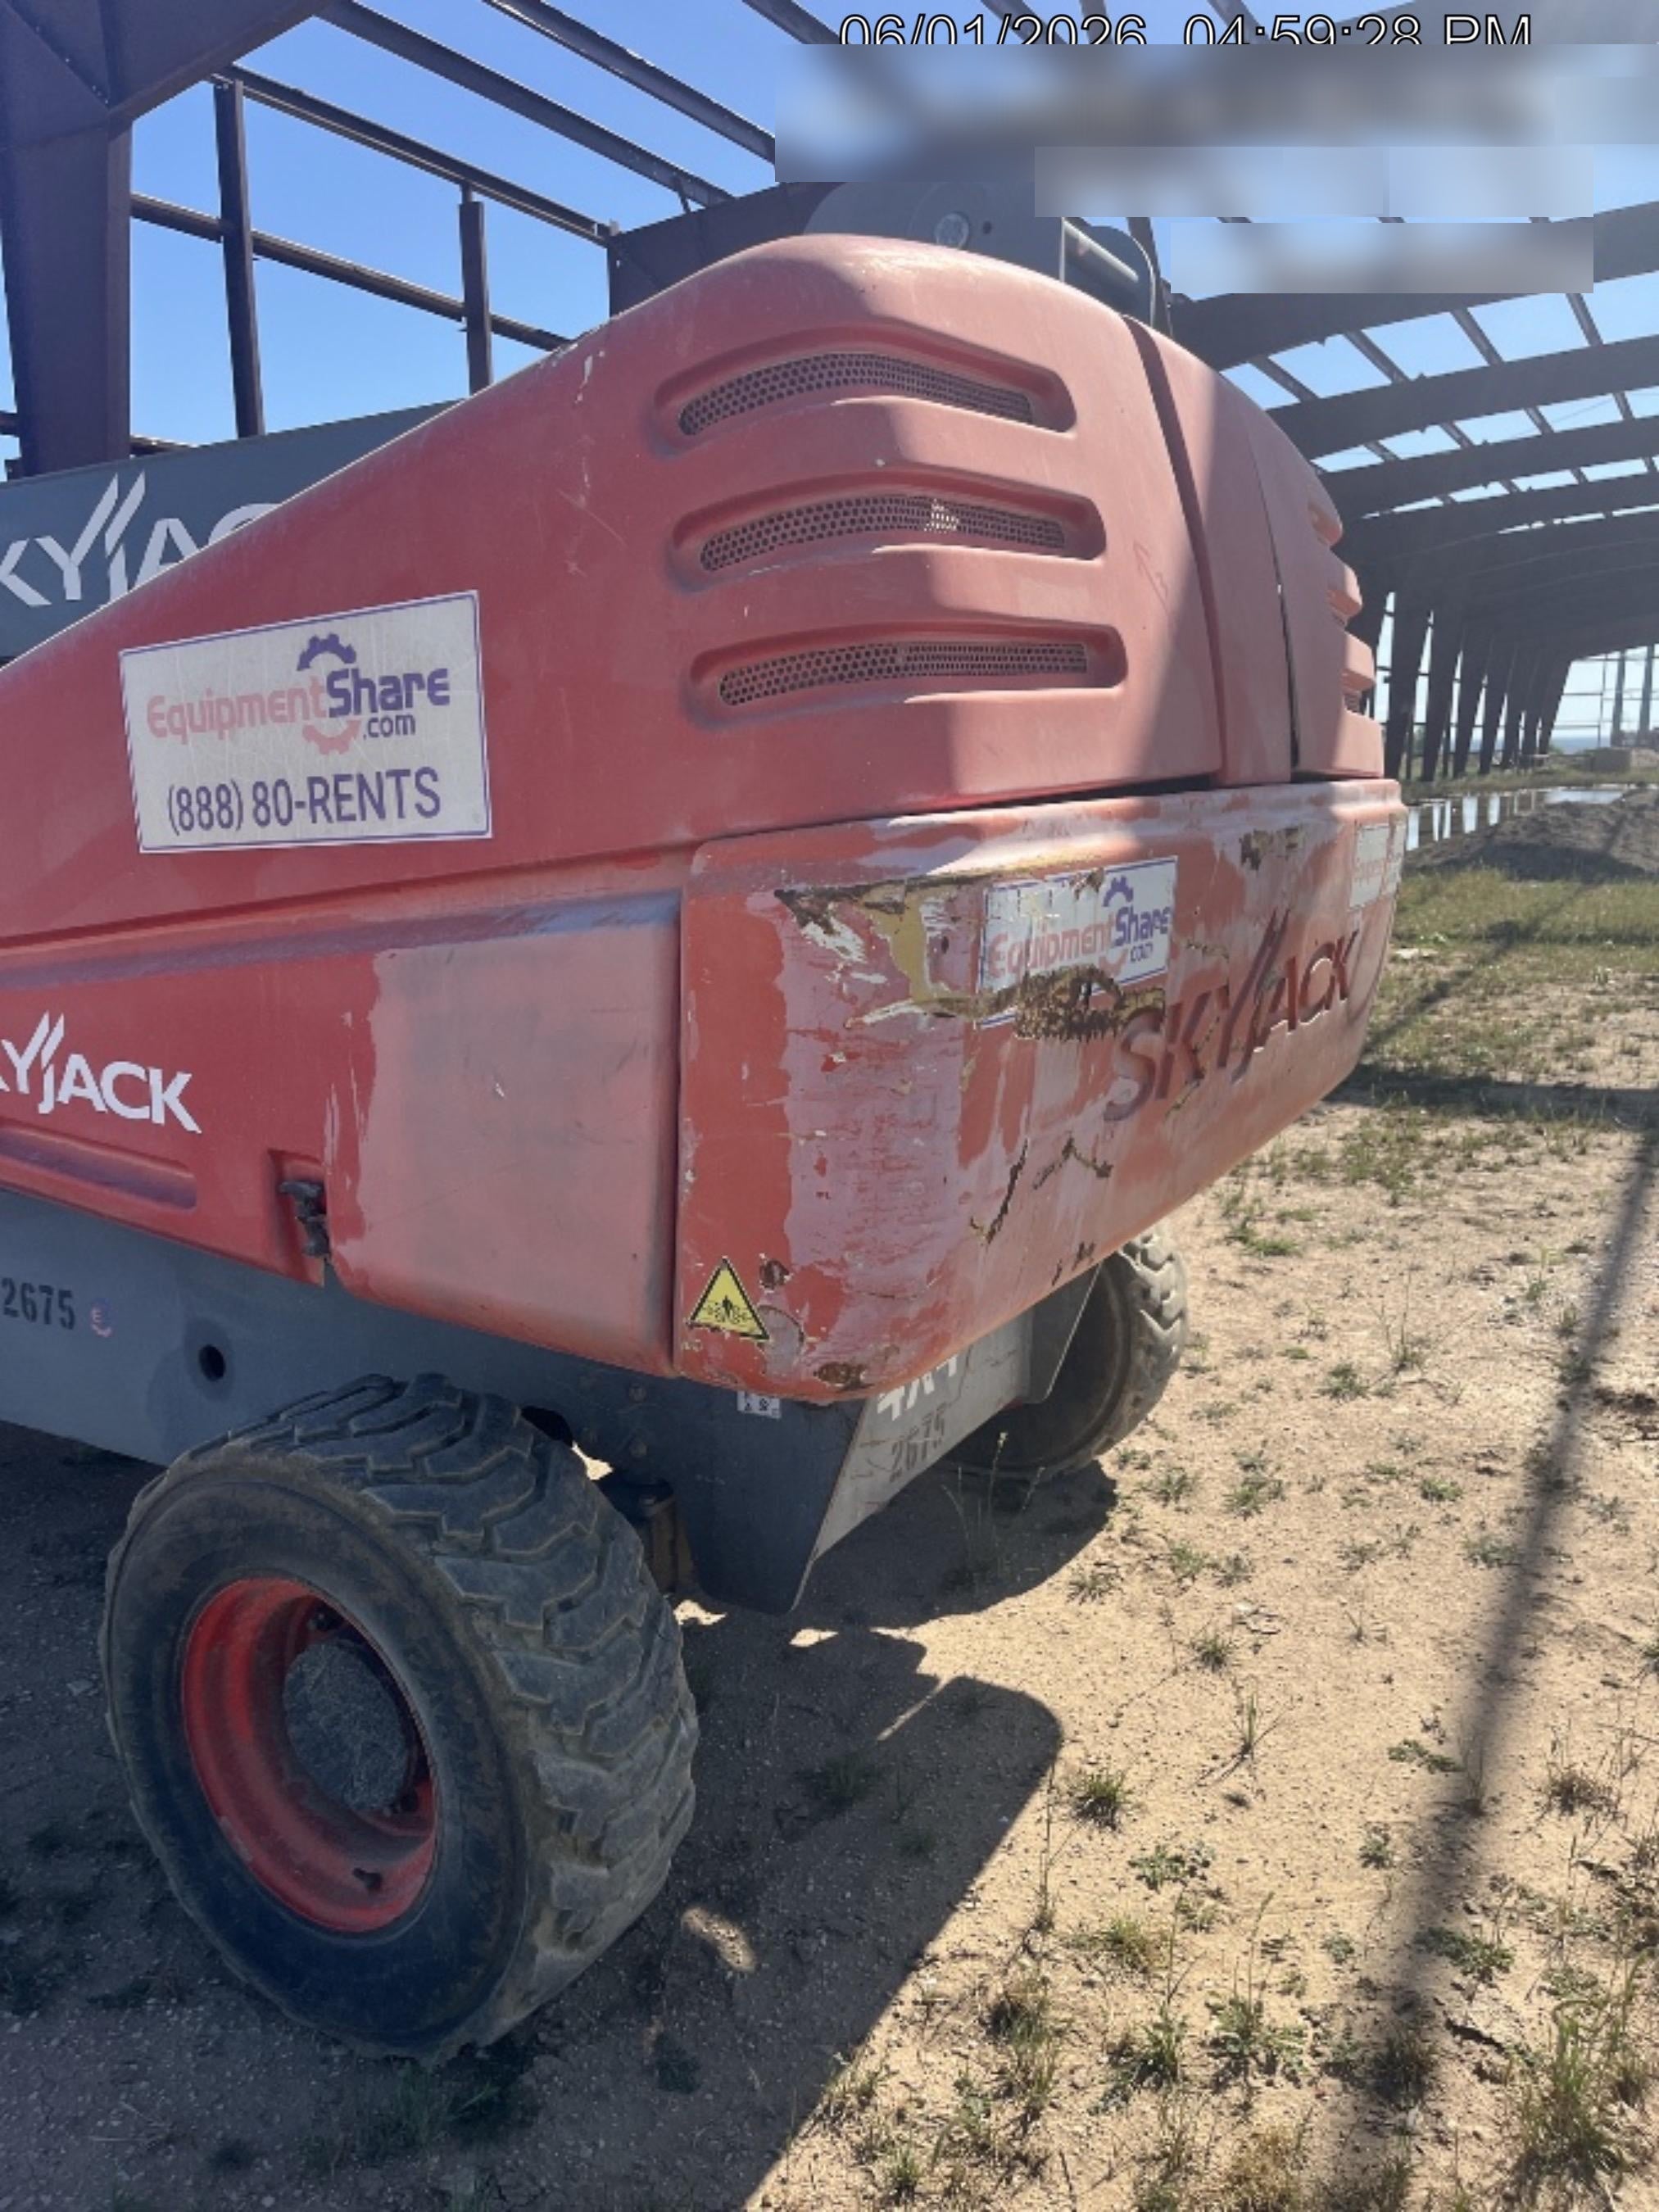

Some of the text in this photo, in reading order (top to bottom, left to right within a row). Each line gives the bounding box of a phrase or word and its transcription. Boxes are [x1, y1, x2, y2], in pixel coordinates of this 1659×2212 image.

[147, 668, 451, 745] EquipmentShare
[362, 714, 416, 740] .com
[167, 767, 441, 836] (888) 80-RENTS
[1104, 908, 1359, 1121] SKYJACK
[1, 1277, 75, 1330] 2675
